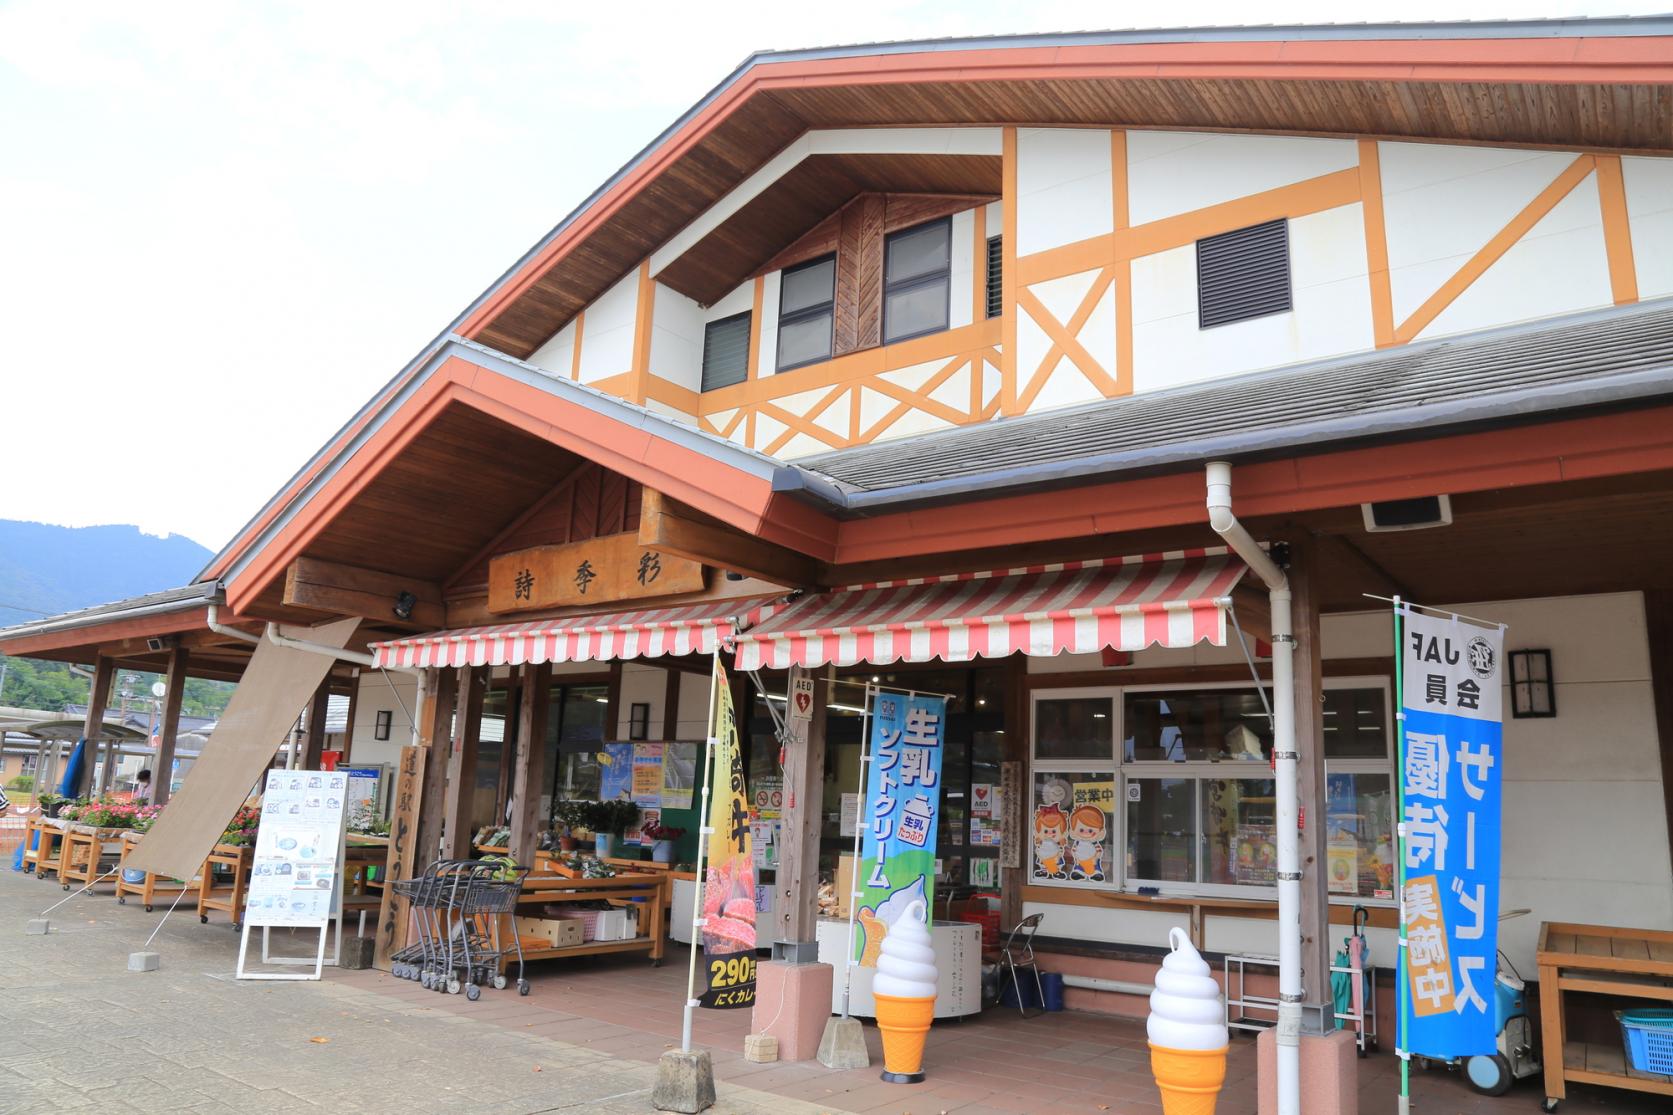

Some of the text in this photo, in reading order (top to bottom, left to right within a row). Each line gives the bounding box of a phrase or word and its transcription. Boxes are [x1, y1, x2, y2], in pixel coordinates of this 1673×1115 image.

[514, 551, 661, 601] 詩季彩
[795, 679, 813, 692] AED
[901, 707, 940, 788] 生乳
[398, 751, 418, 813] 道の駅
[1074, 788, 1114, 803] 営業中
[867, 726, 902, 890] ソフトクリーム
[903, 815, 924, 831] 生乳
[897, 826, 924, 843] たっぷり
[714, 988, 757, 1006] にくカレ
